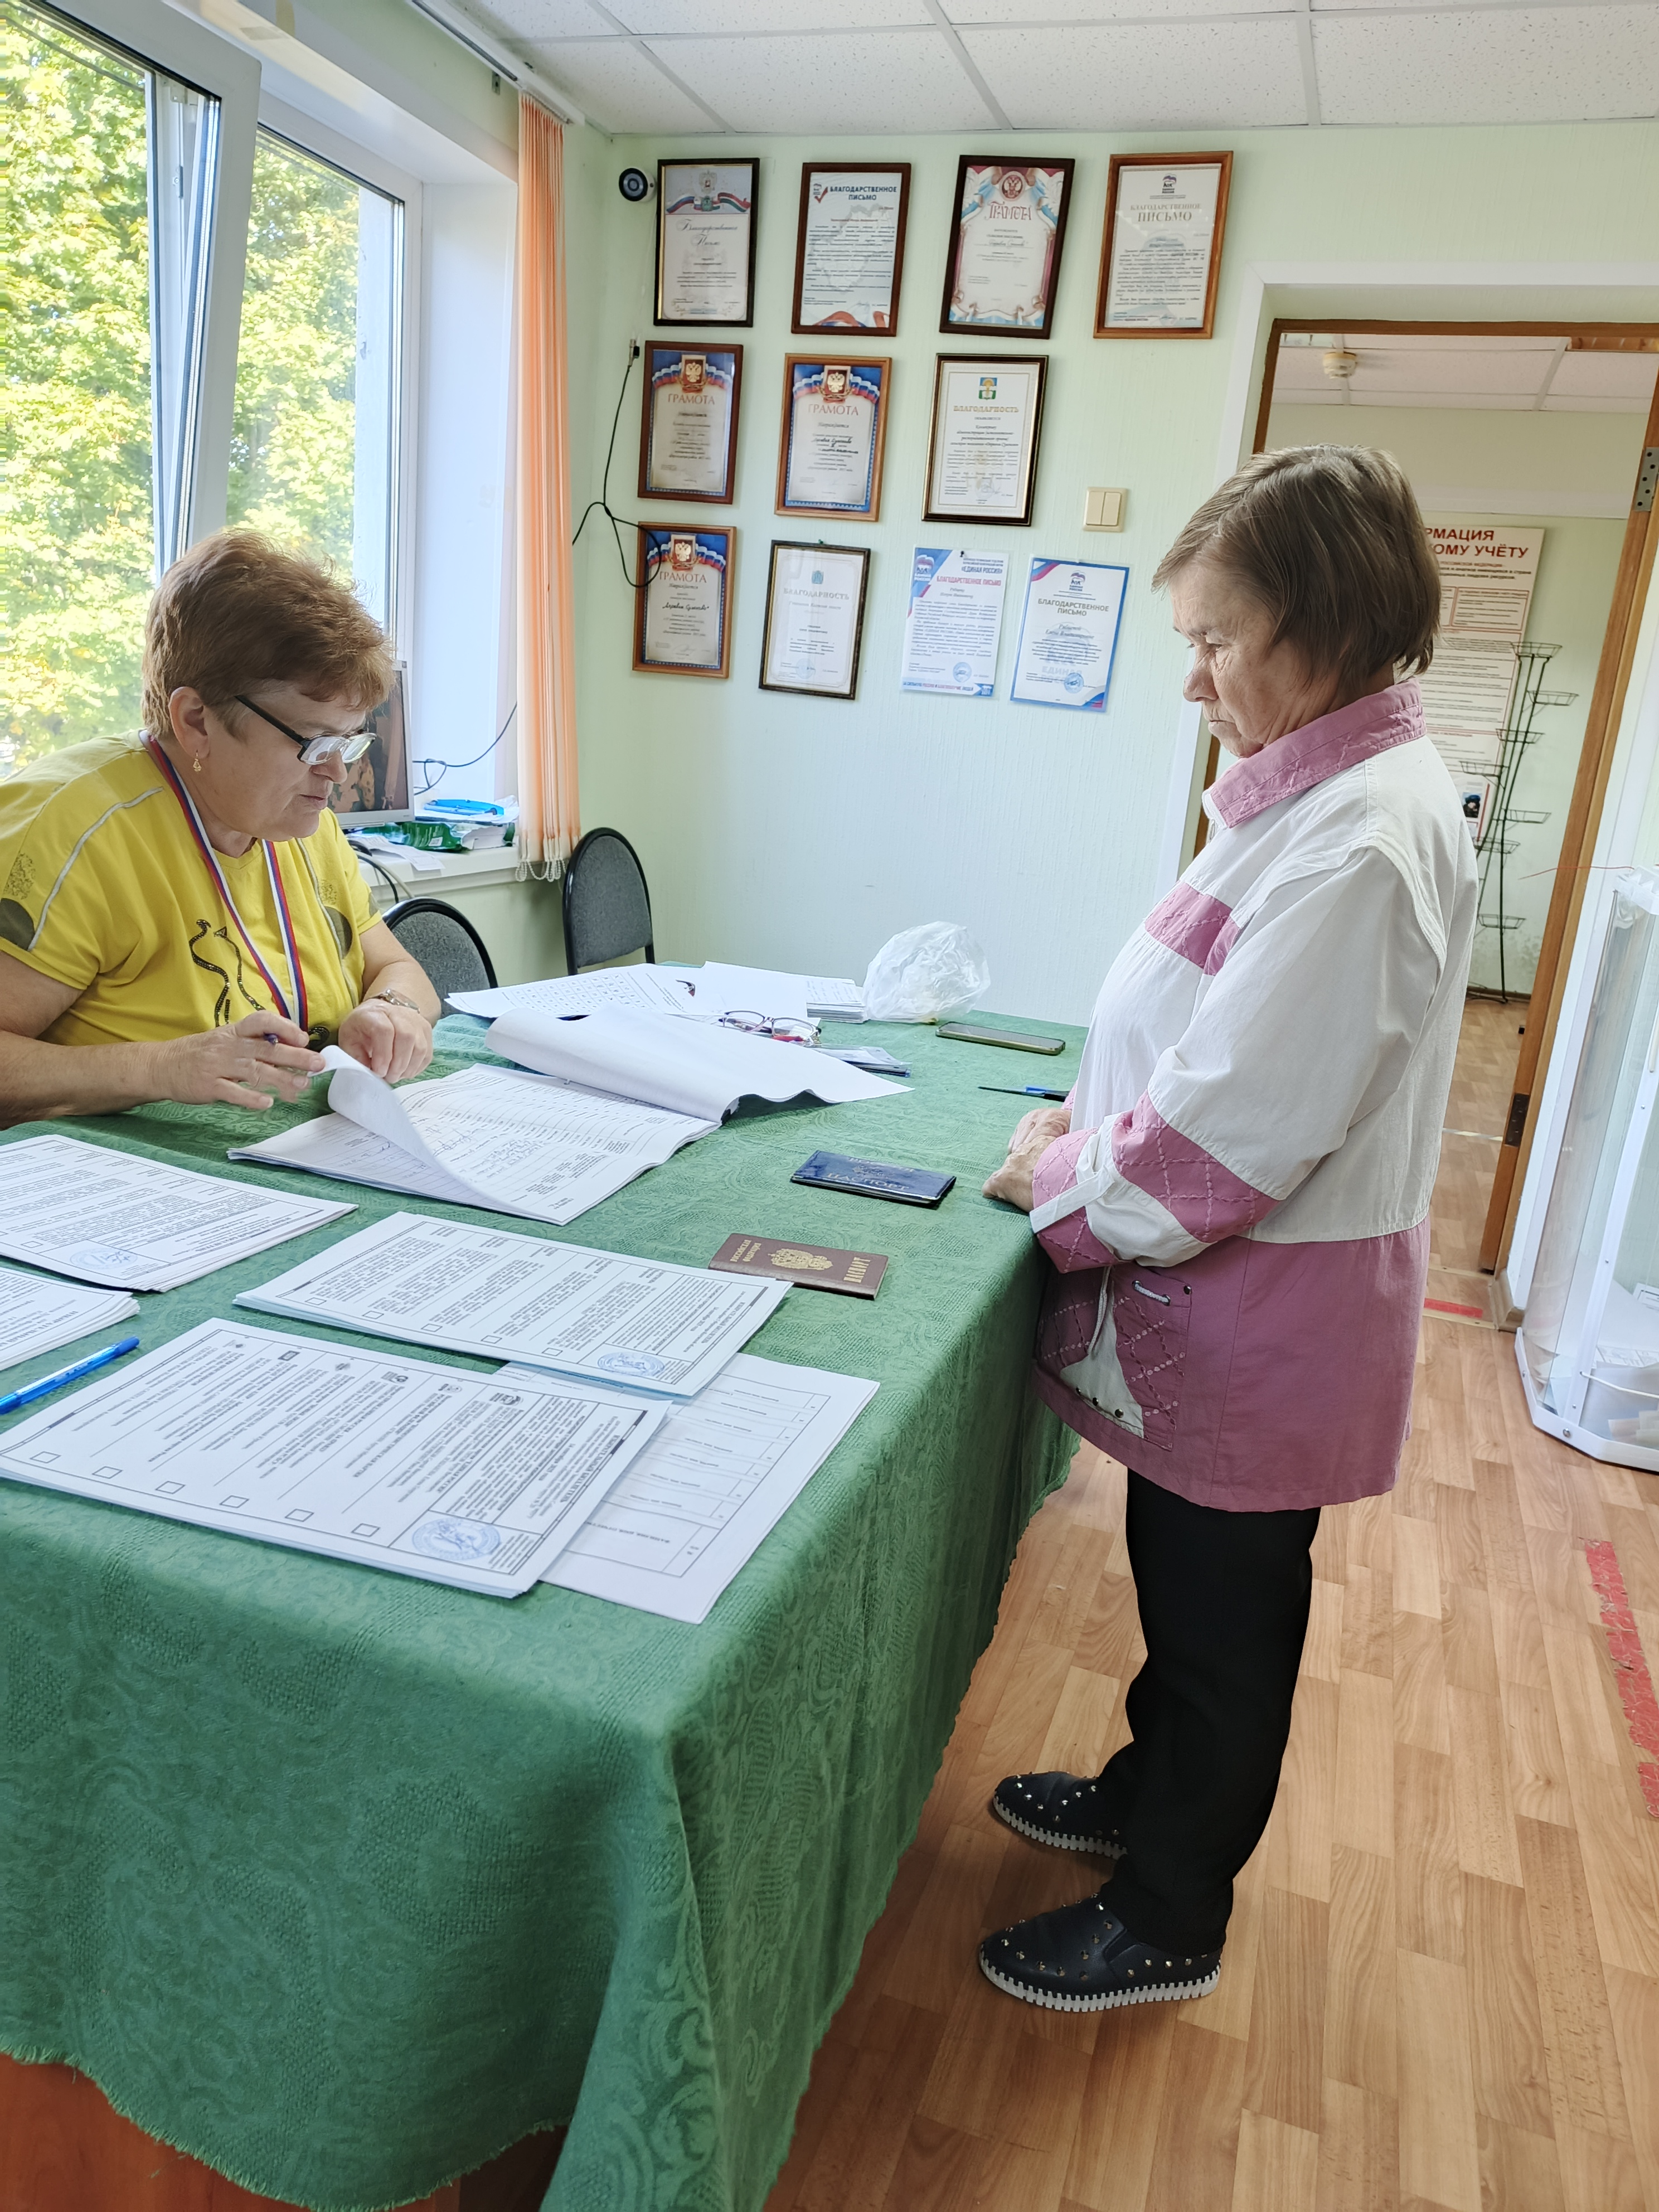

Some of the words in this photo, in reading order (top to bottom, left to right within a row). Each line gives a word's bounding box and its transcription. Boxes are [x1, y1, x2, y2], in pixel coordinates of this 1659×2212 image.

[984, 201, 1031, 220] ГРАМОТА
[1138, 212, 1192, 222] ПИСЬМО
[668, 394, 715, 405] ГРАМОТА
[808, 404, 858, 415] ГРАМОТА
[1474, 544, 1529, 559] УЧЁТУ
[659, 571, 707, 583] ГРАМОТА
[937, 576, 982, 585] БЛАГОДАРСТВЕННОЕ
[783, 588, 850, 600] БЛАГОДАРНОСТЬ
[1038, 598, 1109, 612] БЛАГОДАРСТВЕННОЕ
[1058, 608, 1087, 617] ПИСЬМО
[827, 1173, 909, 1190] ПАСПОРТ
[730, 1239, 752, 1262] РОССИЙСКАЯ
[743, 1243, 761, 1262] ФЕДЕРАЦИЯ
[843, 1257, 871, 1283] ПАСПОРТ
